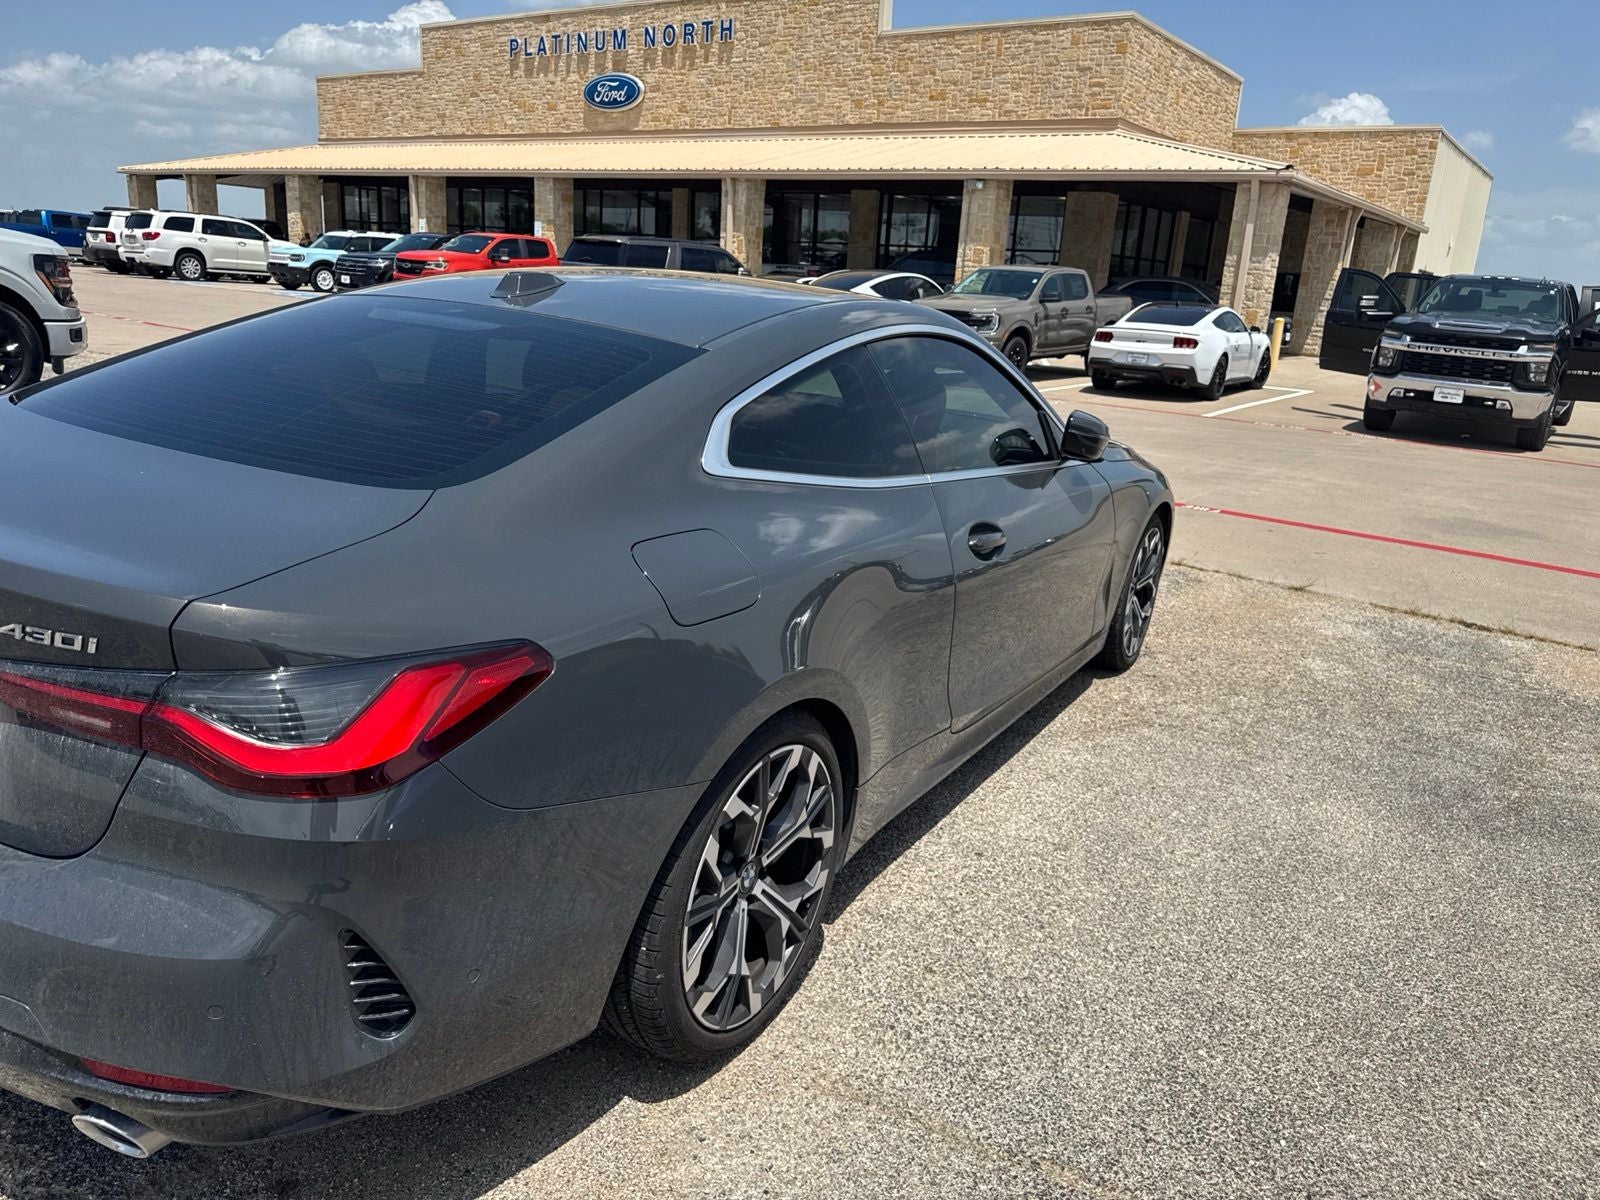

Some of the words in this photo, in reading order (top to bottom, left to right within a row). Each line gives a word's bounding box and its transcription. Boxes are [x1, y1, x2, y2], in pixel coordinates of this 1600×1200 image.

[508, 28, 628, 58] PLATINUM
[643, 18, 735, 48] NORTH
[594, 81, 628, 103] Ford
[1407, 343, 1519, 359] CHEVROLET
[0, 623, 98, 654] 430i
